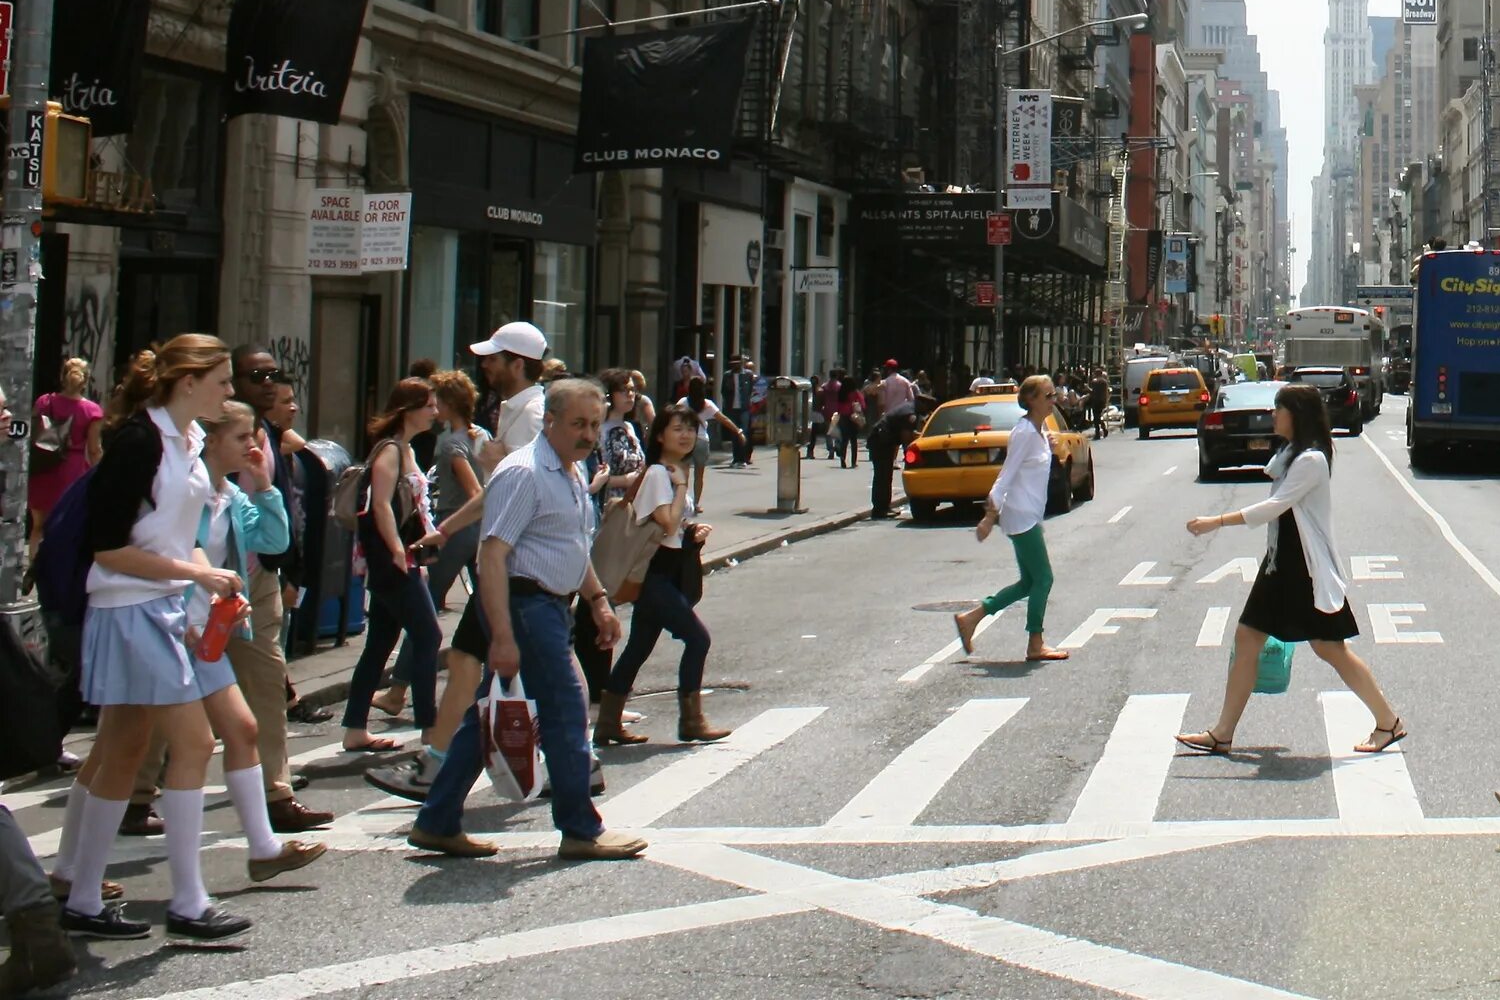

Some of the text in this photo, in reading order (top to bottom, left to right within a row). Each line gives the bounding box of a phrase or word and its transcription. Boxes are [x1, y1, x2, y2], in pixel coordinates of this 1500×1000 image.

[1405, 8, 1435, 21] Broadway
[1012, 110, 1020, 160] INTERNET
[28, 114, 43, 186] KATSU
[1022, 133, 1031, 160] WEEK
[582, 148, 721, 162] CLUB MONACO
[321, 196, 350, 209] SPACE
[368, 200, 400, 211] FLOOR
[310, 210, 360, 222] AVAILABLE
[364, 211, 406, 223] OR RENT
[487, 205, 543, 225] CLUB MONACO
[925, 210, 993, 220] SPITALFIELD
[1457, 337, 1472, 346] Hop
[1118, 555, 1405, 586] LAE
[1057, 602, 1444, 648] FIE
